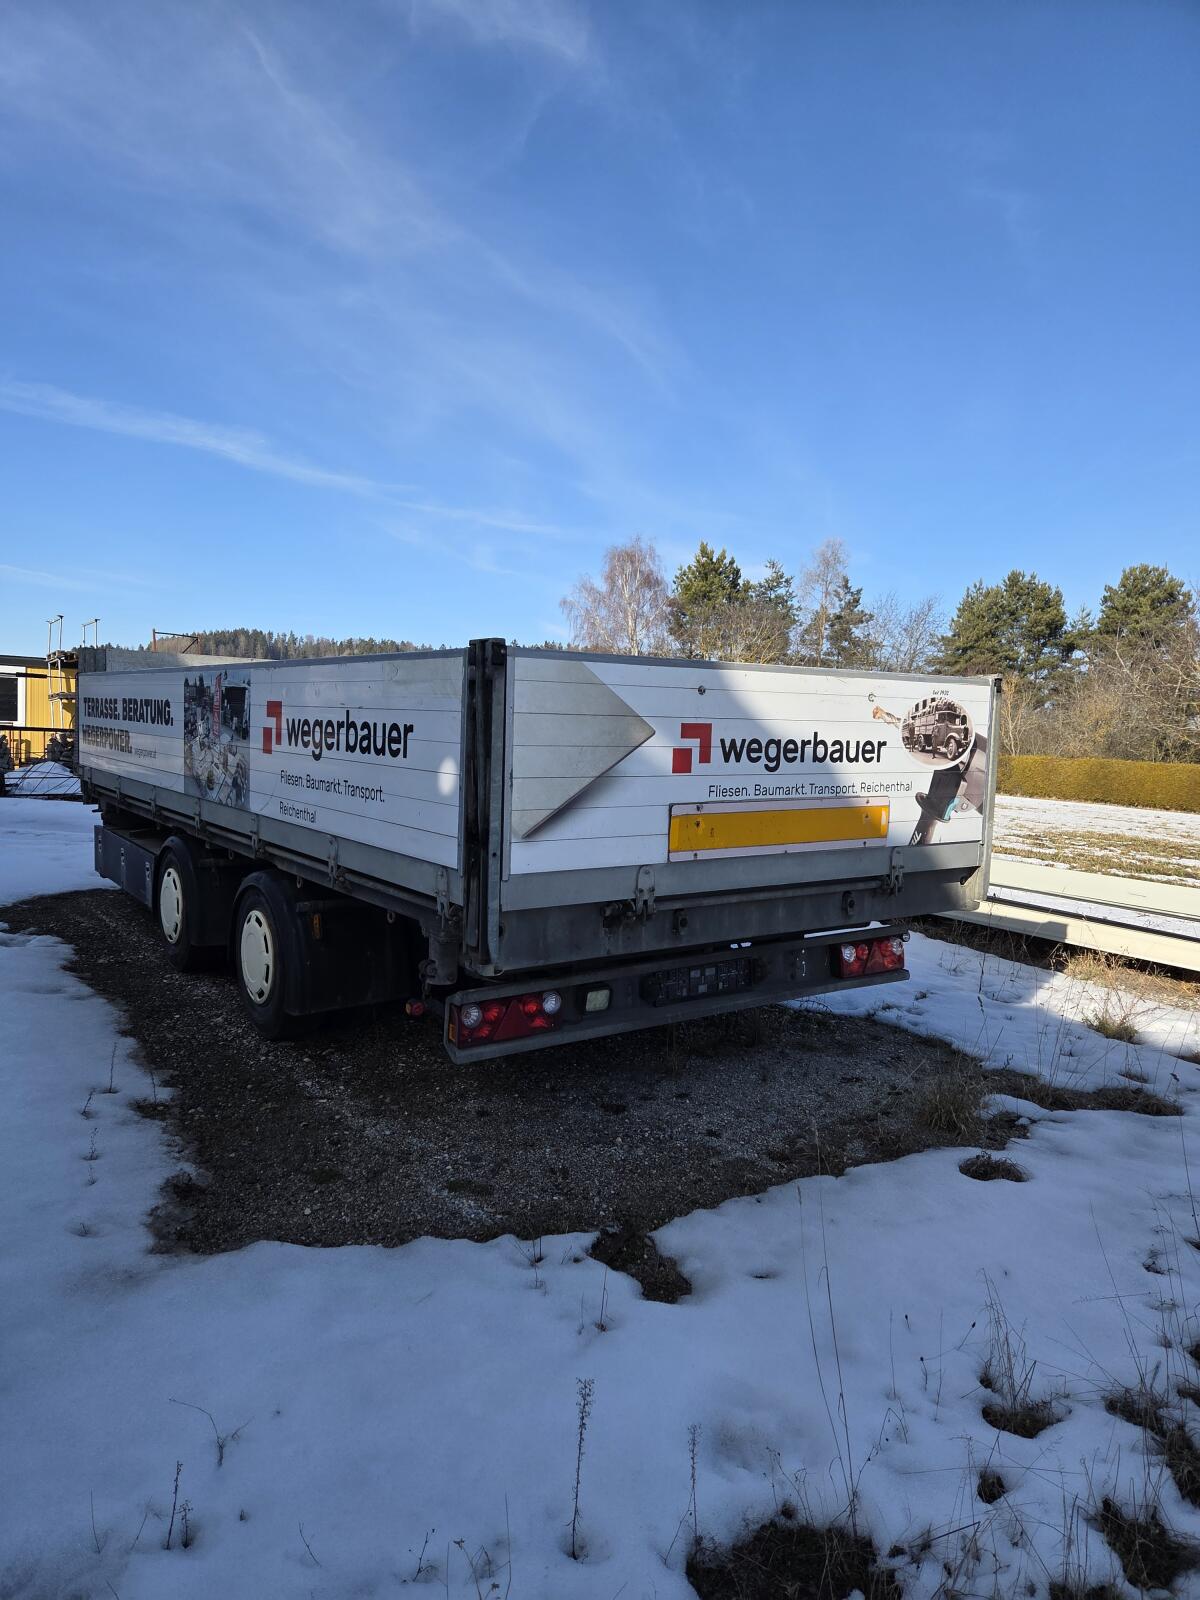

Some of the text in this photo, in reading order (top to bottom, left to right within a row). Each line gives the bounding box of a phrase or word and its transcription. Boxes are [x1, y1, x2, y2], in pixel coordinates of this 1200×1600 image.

[83, 697, 174, 726] TERRASSE. BERATUNG.
[82, 723, 133, 754] WEGERPOWER.
[286, 709, 414, 761] wegerbauer
[720, 731, 887, 773] wegerbauer
[280, 769, 385, 803] Fliesen. Baumarkt. Transport.
[708, 781, 913, 798] Fliesen. Baumarkt. Transport. Reichenthal
[279, 800, 317, 823] Reichenthal
